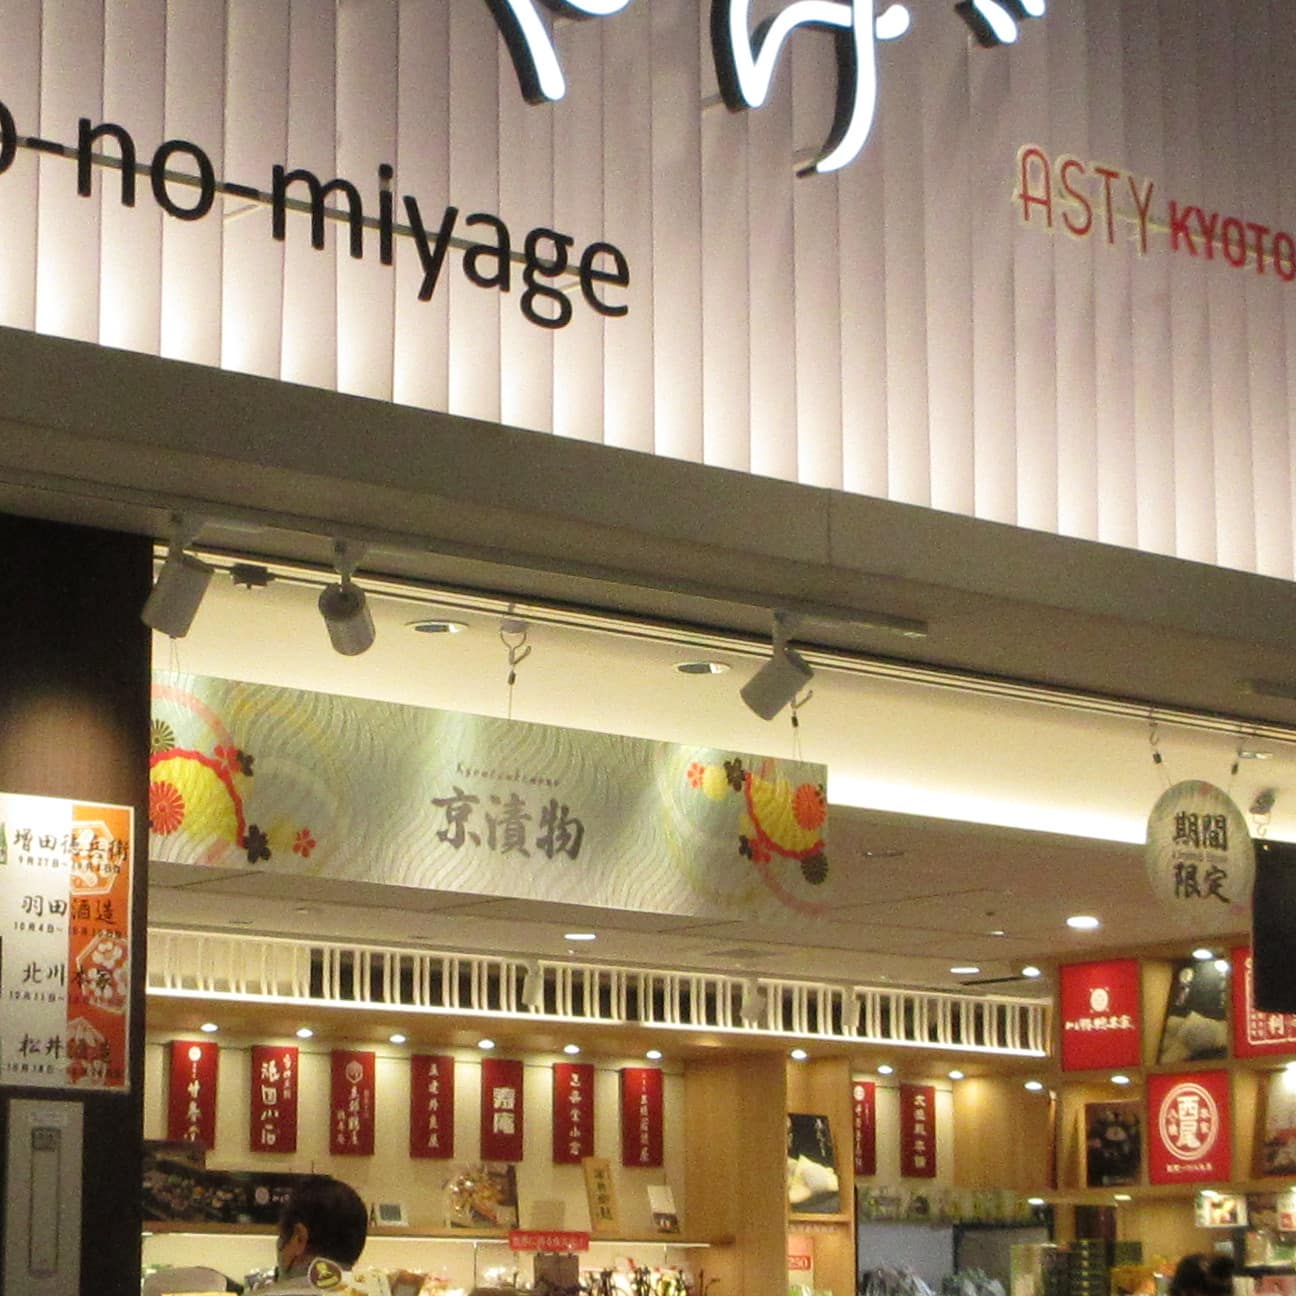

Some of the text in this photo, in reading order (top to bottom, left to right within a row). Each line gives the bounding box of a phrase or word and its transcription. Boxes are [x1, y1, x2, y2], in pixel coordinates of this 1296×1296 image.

[1018, 147, 1155, 254] ASTY
[431, 784, 585, 861] 京漬物
[1172, 810, 1229, 852] 期間
[1172, 862, 1231, 905] 限定
[21, 894, 117, 926] 羽田酒造
[1176, 1095, 1202, 1148] 西尾
